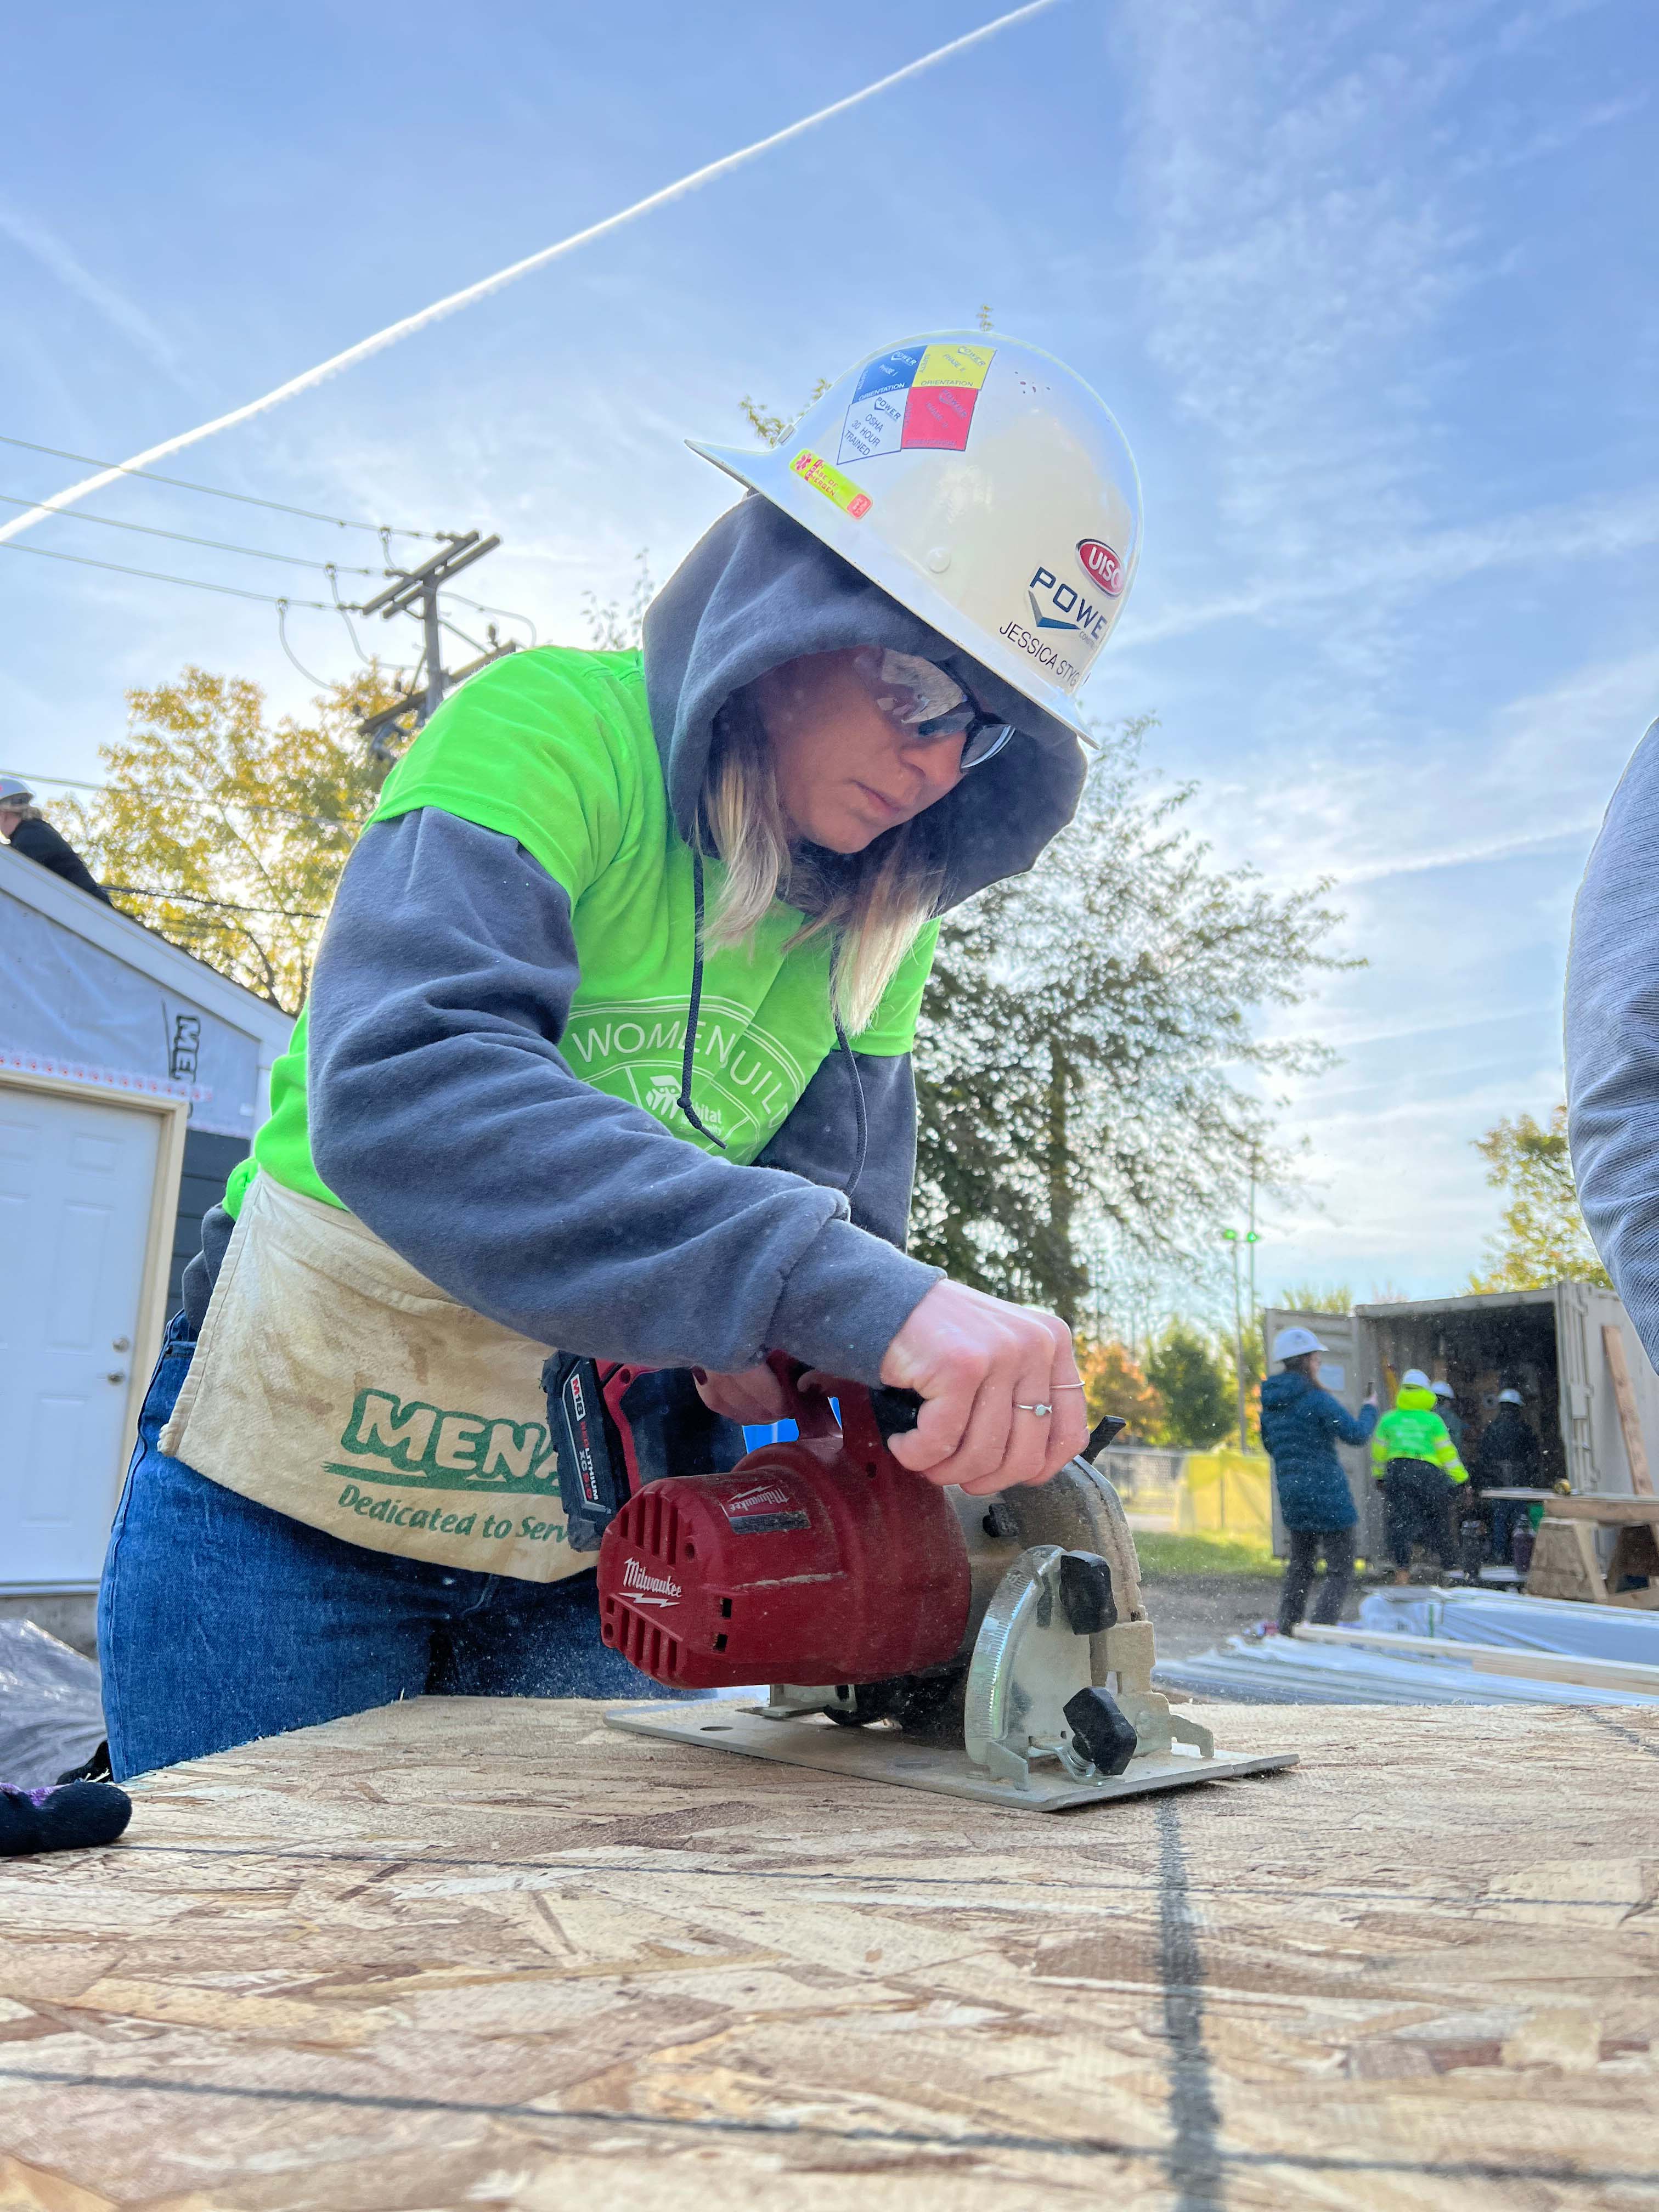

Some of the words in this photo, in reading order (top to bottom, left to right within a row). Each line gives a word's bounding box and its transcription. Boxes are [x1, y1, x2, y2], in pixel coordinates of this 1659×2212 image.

[858, 382, 906, 402] ORIENTATION
[878, 397, 901, 420] POWER
[851, 420, 861, 430] 30
[860, 426, 881, 447] HOUR
[865, 414, 884, 433] OSHA
[845, 430, 871, 456] TRAINED
[806, 471, 843, 500] EMERGEN
[828, 479, 839, 488] OF
[1029, 566, 1108, 642] POWE
[1000, 621, 1058, 669] JESSICA
[572, 1020, 736, 1063] WOMEN
[720, 1050, 788, 1128] UILD
[572, 1377, 584, 1417] M18
[338, 1484, 477, 1536] Dedicated
[482, 1514, 512, 1539] to
[515, 1516, 569, 1543] Serv
[729, 1488, 790, 1513] Milwaukee
[623, 1556, 683, 1598] Milwaukee
